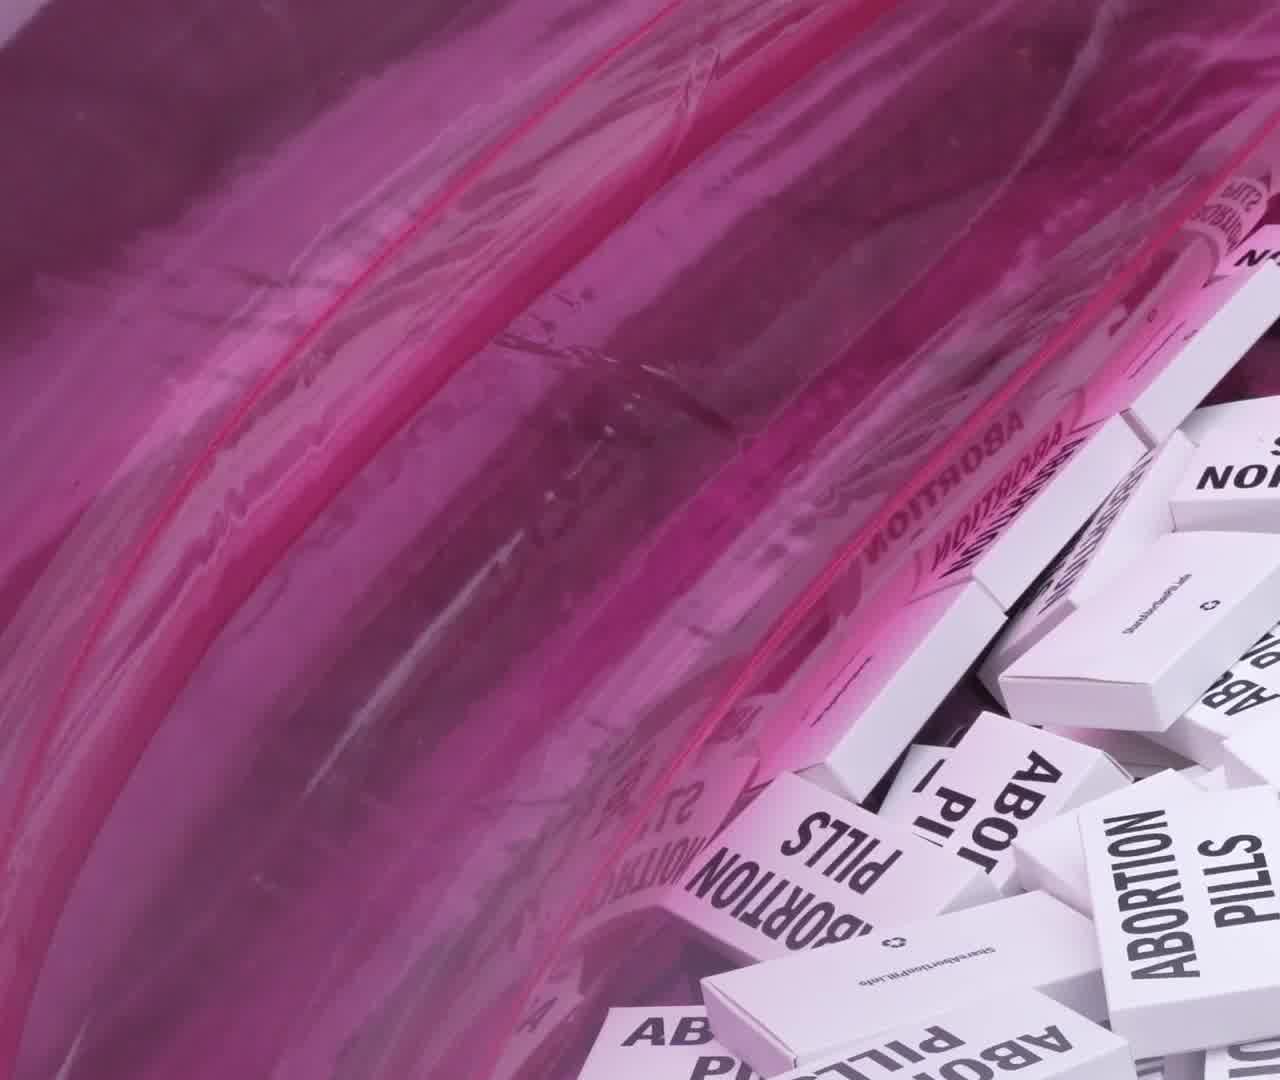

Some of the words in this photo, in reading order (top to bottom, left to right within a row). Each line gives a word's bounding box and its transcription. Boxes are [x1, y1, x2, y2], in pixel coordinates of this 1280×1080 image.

[684, 846, 874, 952] BORTION
[780, 810, 904, 896] PILLS
[1104, 808, 1201, 981] ABORTION
[1197, 833, 1280, 930] PILLS
[858, 946, 997, 987] ShareAbortionPill.info
